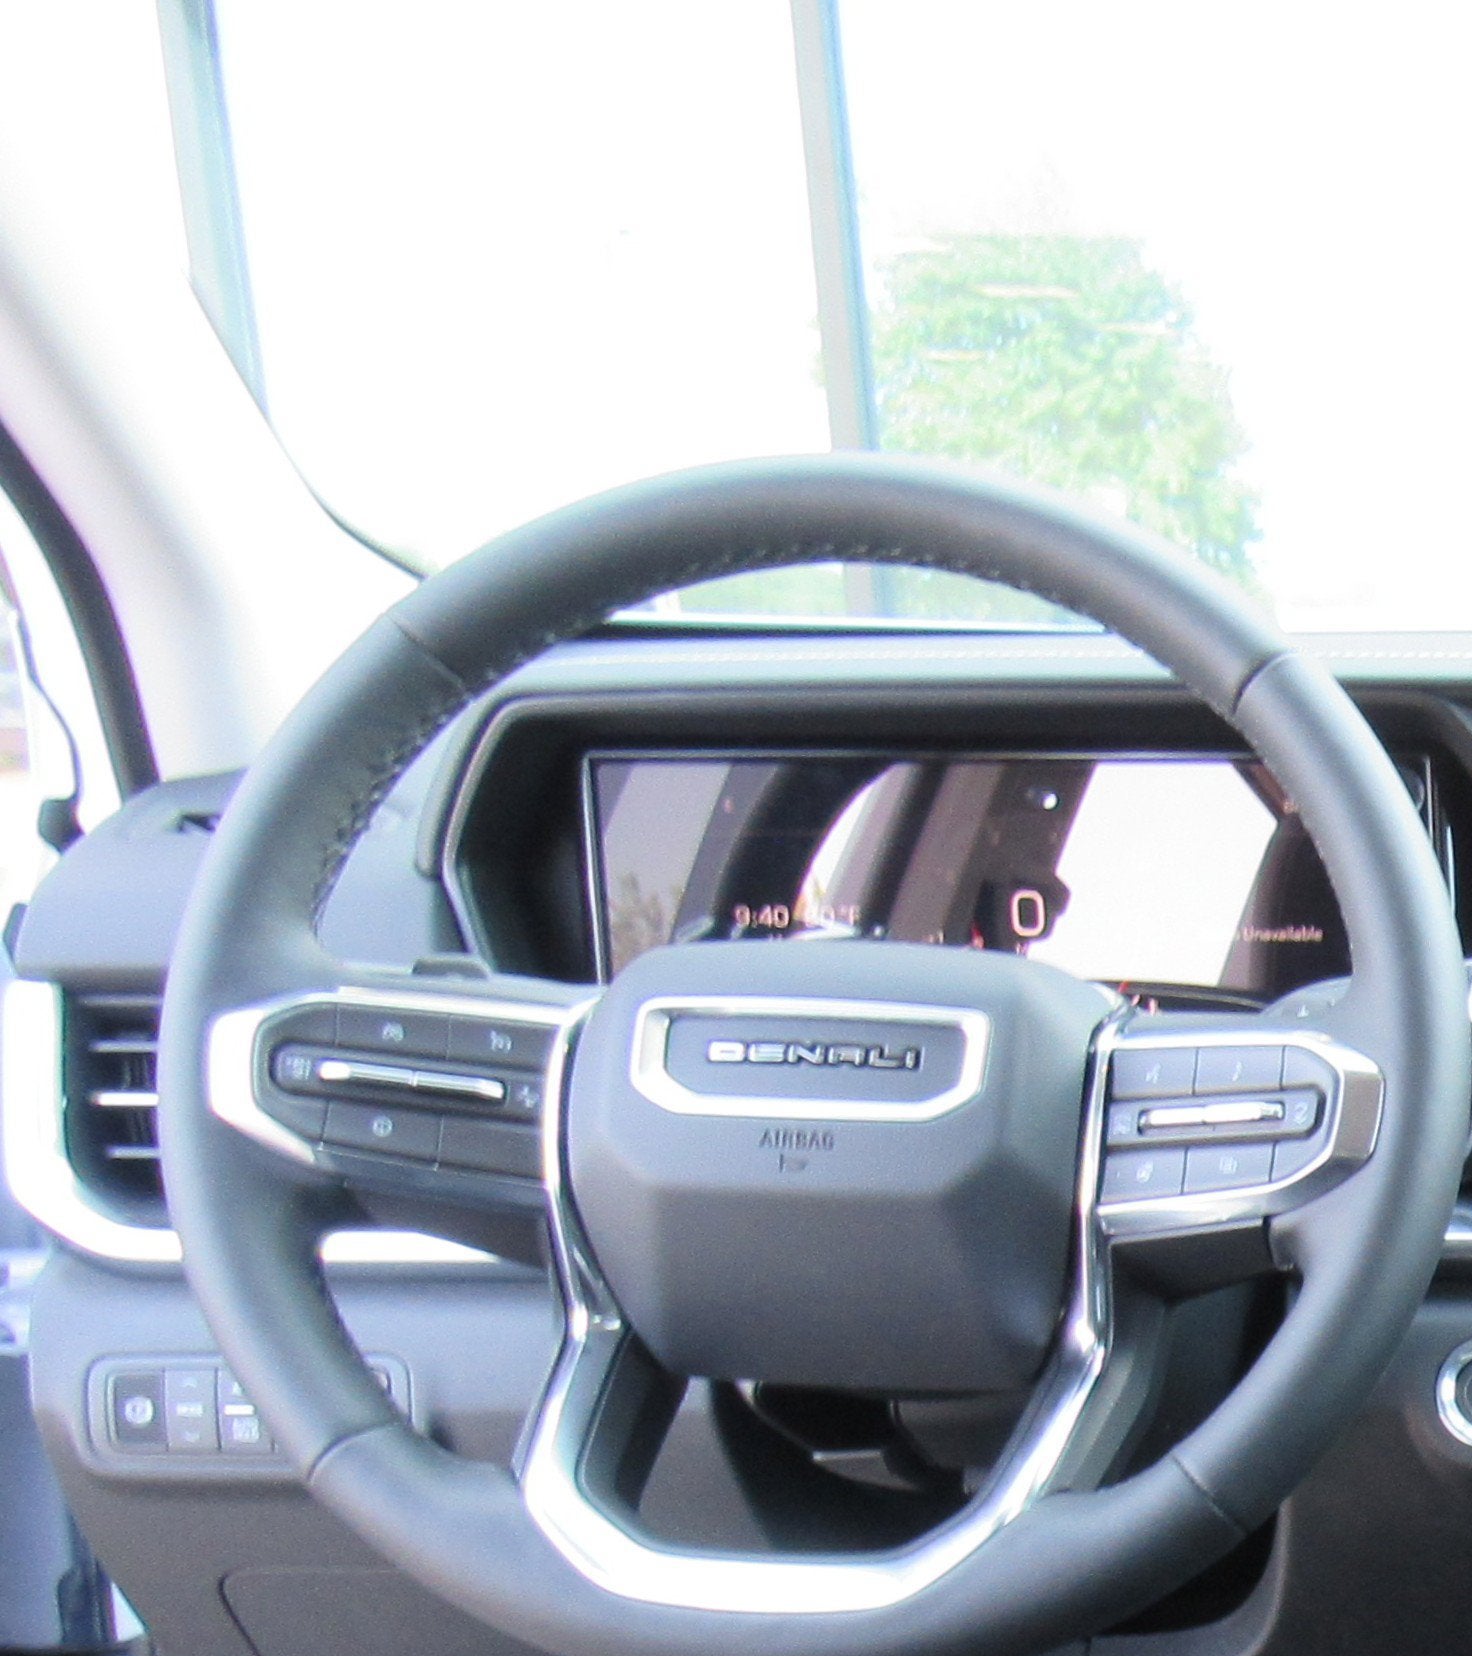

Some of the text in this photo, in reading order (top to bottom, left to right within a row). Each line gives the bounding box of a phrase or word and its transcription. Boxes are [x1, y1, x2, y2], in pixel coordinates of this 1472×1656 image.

[733, 903, 790, 928] 9:40
[707, 1039, 922, 1071] DENALI
[758, 1128, 835, 1151] AIRBAG
